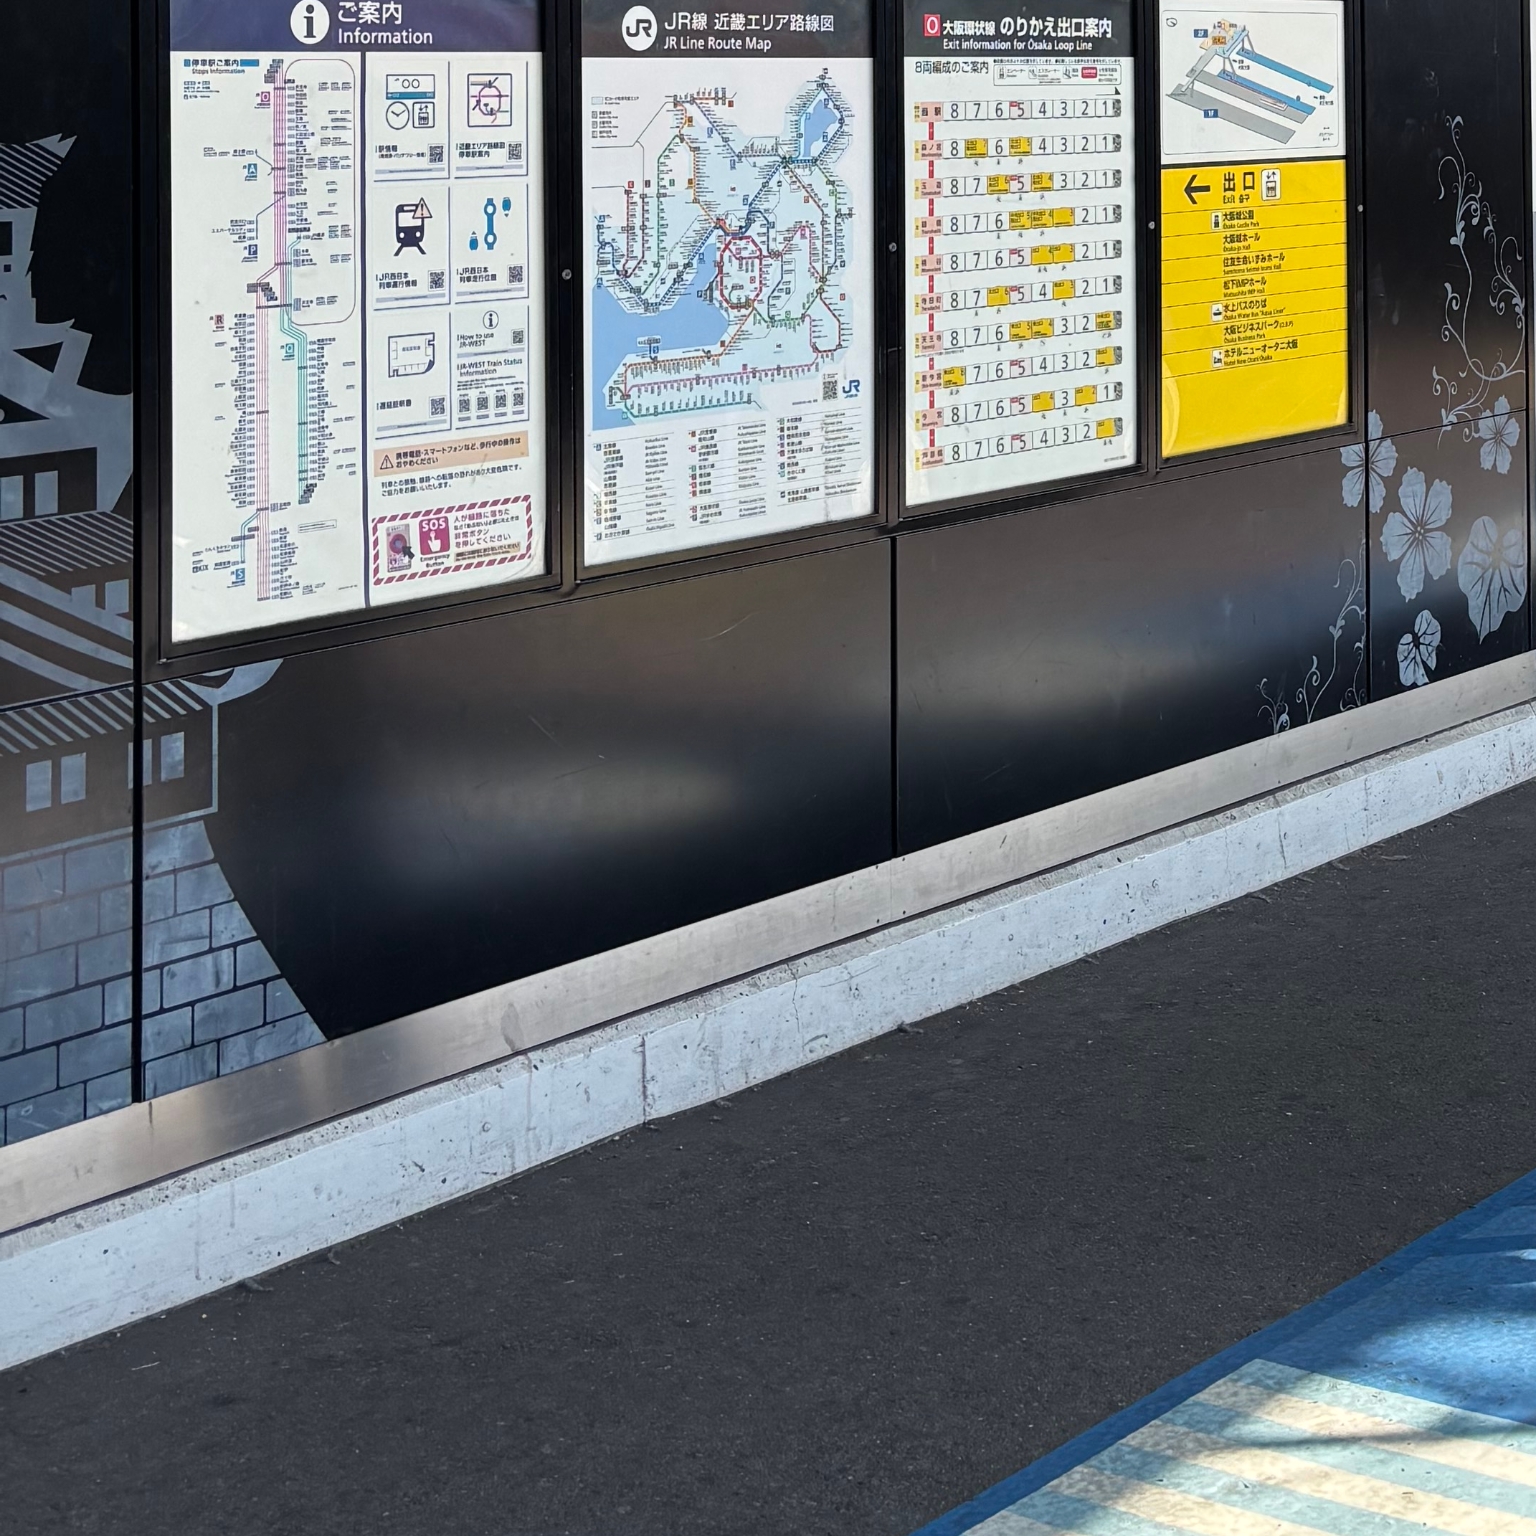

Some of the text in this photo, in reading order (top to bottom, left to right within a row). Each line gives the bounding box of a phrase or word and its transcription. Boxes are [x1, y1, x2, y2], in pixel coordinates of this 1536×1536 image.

[338, 1, 402, 25] ご案内
[664, 12, 834, 32] JR線 近畿エリア路線図
[338, 27, 433, 44] Information
[626, 19, 653, 38] JR
[942, 20, 996, 36] 大阪環状線
[1000, 17, 1112, 38] のりかえ出口案内
[664, 37, 772, 52] JR Line Route Map
[943, 39, 959, 50] Exit
[962, 39, 1011, 50] information
[1014, 39, 1026, 50] for
[1054, 39, 1074, 53] Loop
[1076, 39, 1092, 50] Line
[915, 61, 989, 75] 8両編成のご案内
[951, 100, 1107, 118] 8 7 6 5 4 3 2 1
[951, 136, 1107, 156] 8 6 4 3 2 1
[951, 179, 958, 194] 8
[973, 178, 980, 193] 7
[1018, 175, 1024, 190] 5
[1061, 173, 1067, 188] 3
[1082, 172, 1088, 187] 2
[1102, 171, 1107, 185] 1
[1224, 172, 1255, 192] 出口
[1223, 195, 1235, 204] Exit
[951, 331, 958, 346] 8
[973, 328, 980, 343] 7
[996, 325, 1003, 340] 6
[1061, 318, 1068, 333] 3
[1083, 316, 1089, 330] 2
[487, 359, 503, 368] Train
[503, 358, 523, 366] Status
[842, 379, 860, 394] JR
[422, 518, 446, 532] SOS
